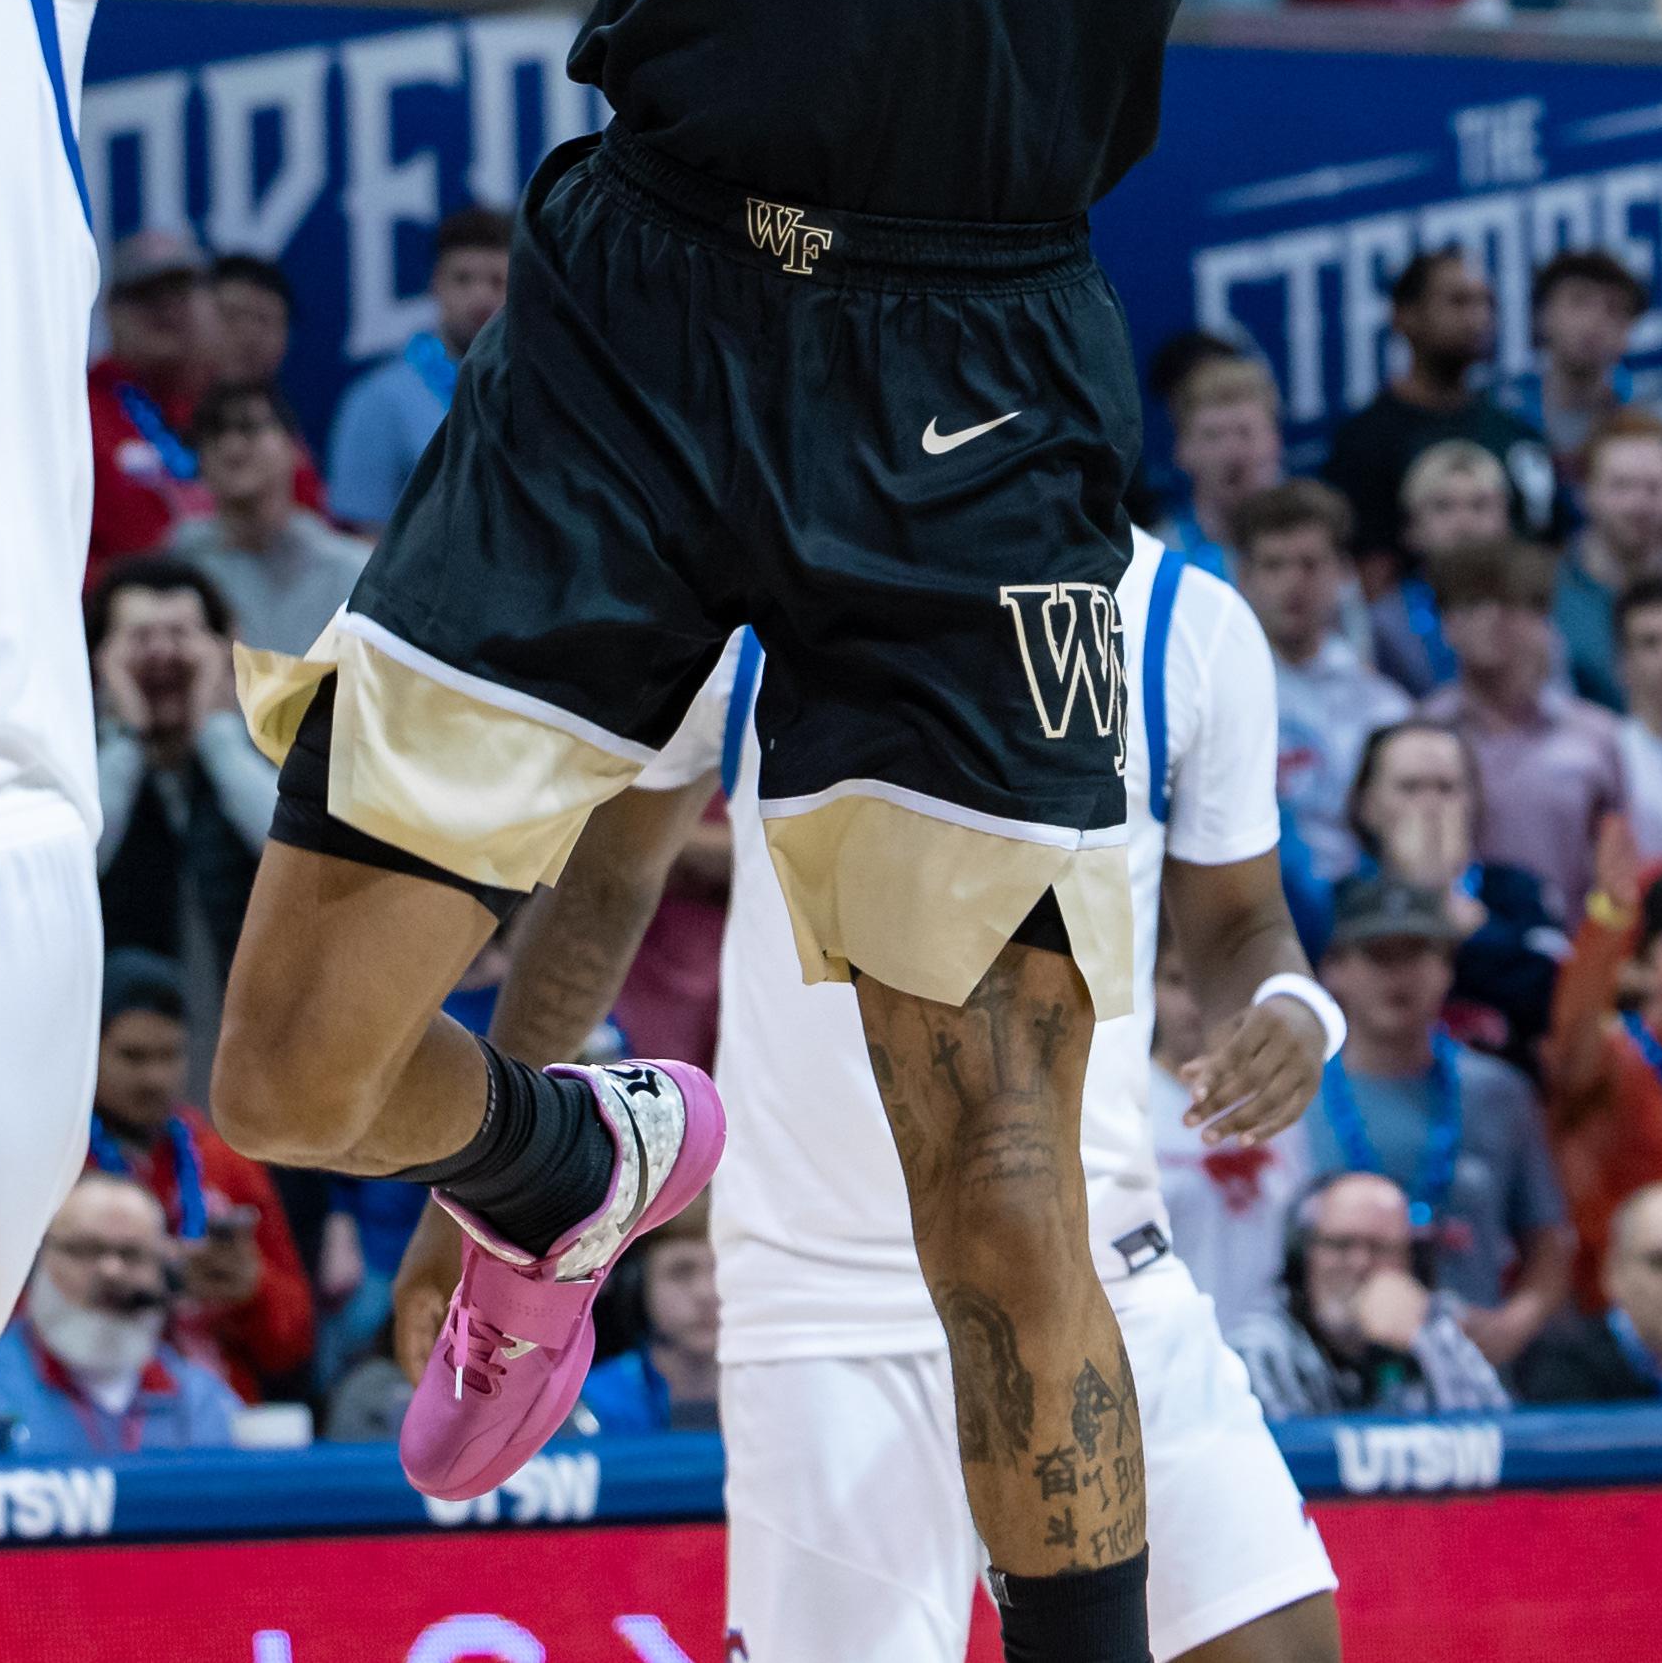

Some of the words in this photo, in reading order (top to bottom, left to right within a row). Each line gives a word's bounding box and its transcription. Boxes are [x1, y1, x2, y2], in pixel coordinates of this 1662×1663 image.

[1451, 96, 1545, 186] THE
[746, 196, 833, 275] WF
[1032, 1443, 1079, 1550] 奋斗
[1336, 1423, 1503, 1493] UTSW
